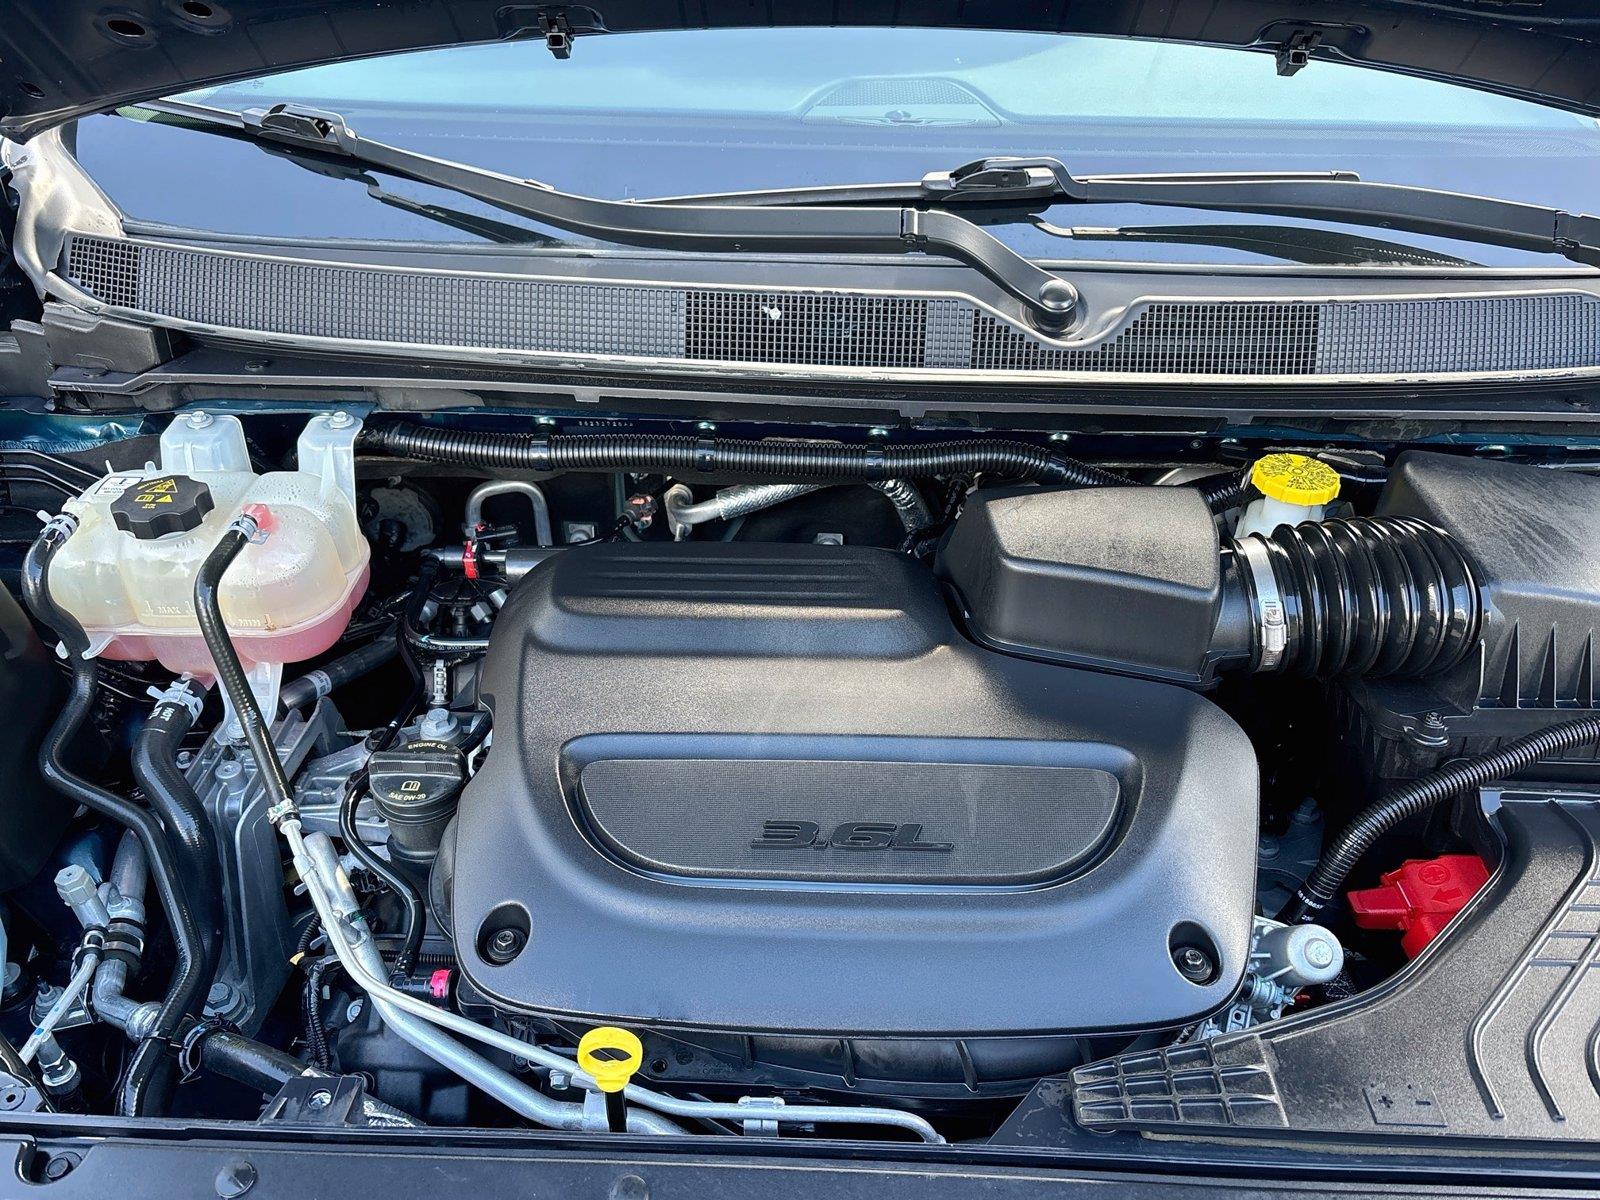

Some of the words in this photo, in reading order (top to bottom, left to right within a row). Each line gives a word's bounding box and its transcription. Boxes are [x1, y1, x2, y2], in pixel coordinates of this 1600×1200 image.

[407, 742, 436, 750] ENGINE
[437, 743, 448, 751] OIL
[388, 792, 402, 800] SAE
[403, 793, 427, 801] 0W-20
[750, 818, 955, 852] 3.6L
